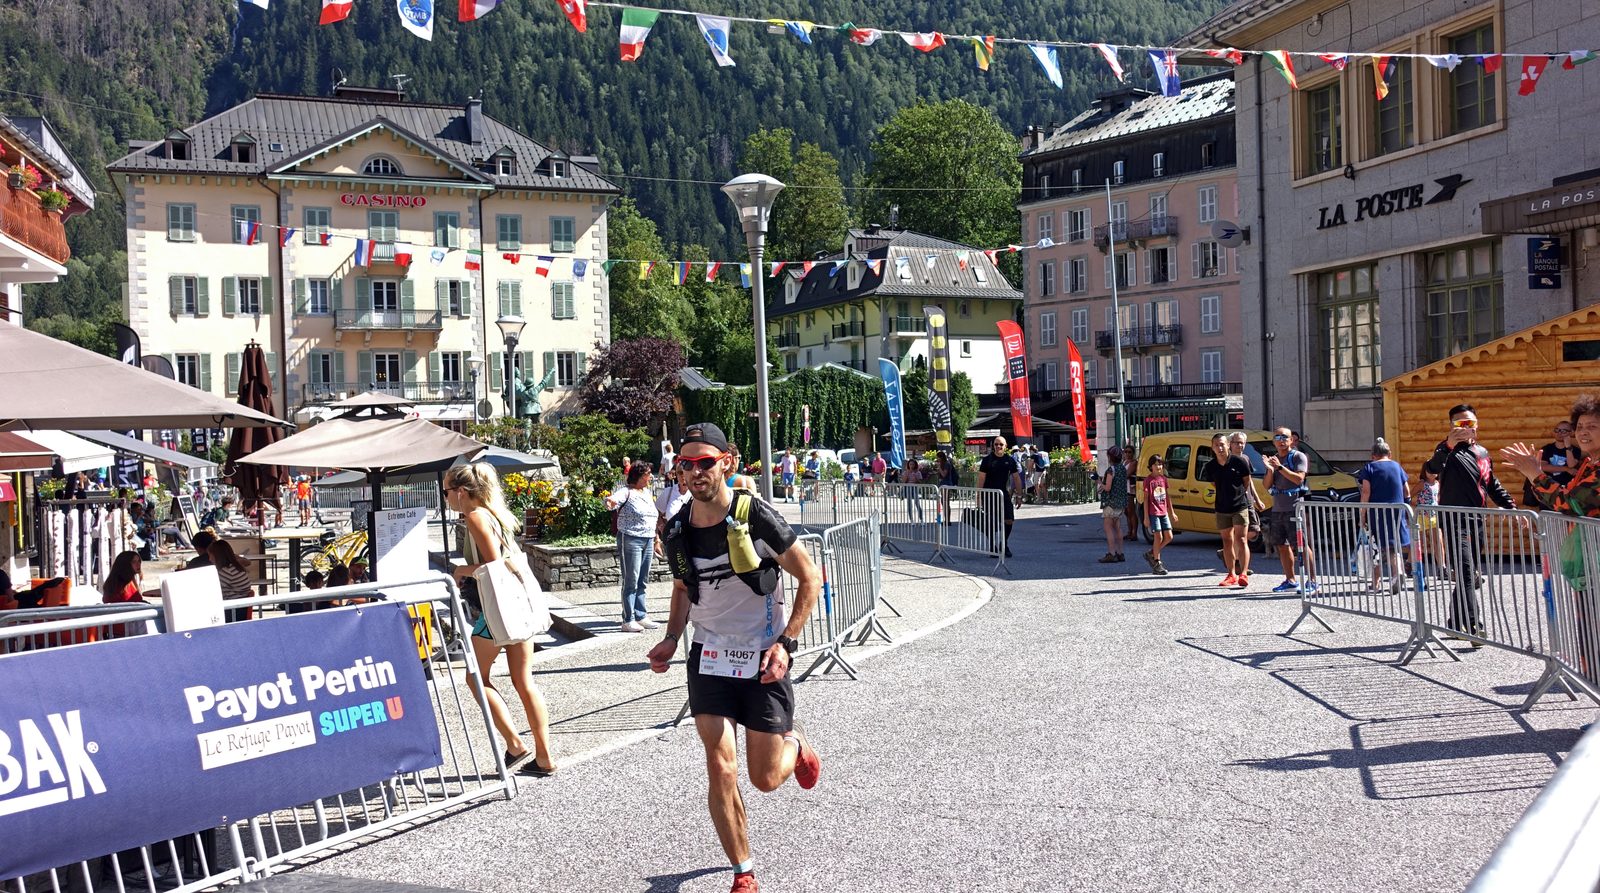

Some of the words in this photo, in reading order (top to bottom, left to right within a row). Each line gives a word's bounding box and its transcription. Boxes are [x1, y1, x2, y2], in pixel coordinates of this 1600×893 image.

[340, 193, 427, 207] CASINO
[1316, 203, 1348, 230] LA
[1354, 183, 1424, 222] POSTE
[1531, 200, 1551, 212] LA
[1561, 190, 1600, 205] POS
[388, 512, 406, 521] Extreme
[406, 509, 417, 519] Café
[723, 649, 756, 660] 14067
[184, 672, 297, 724] Payot
[300, 655, 397, 701] Pertin
[319, 701, 388, 737] SUPER
[388, 696, 404, 721] U
[203, 737, 224, 758] Le
[228, 725, 273, 756] Refuge
[274, 719, 312, 749] Payot
